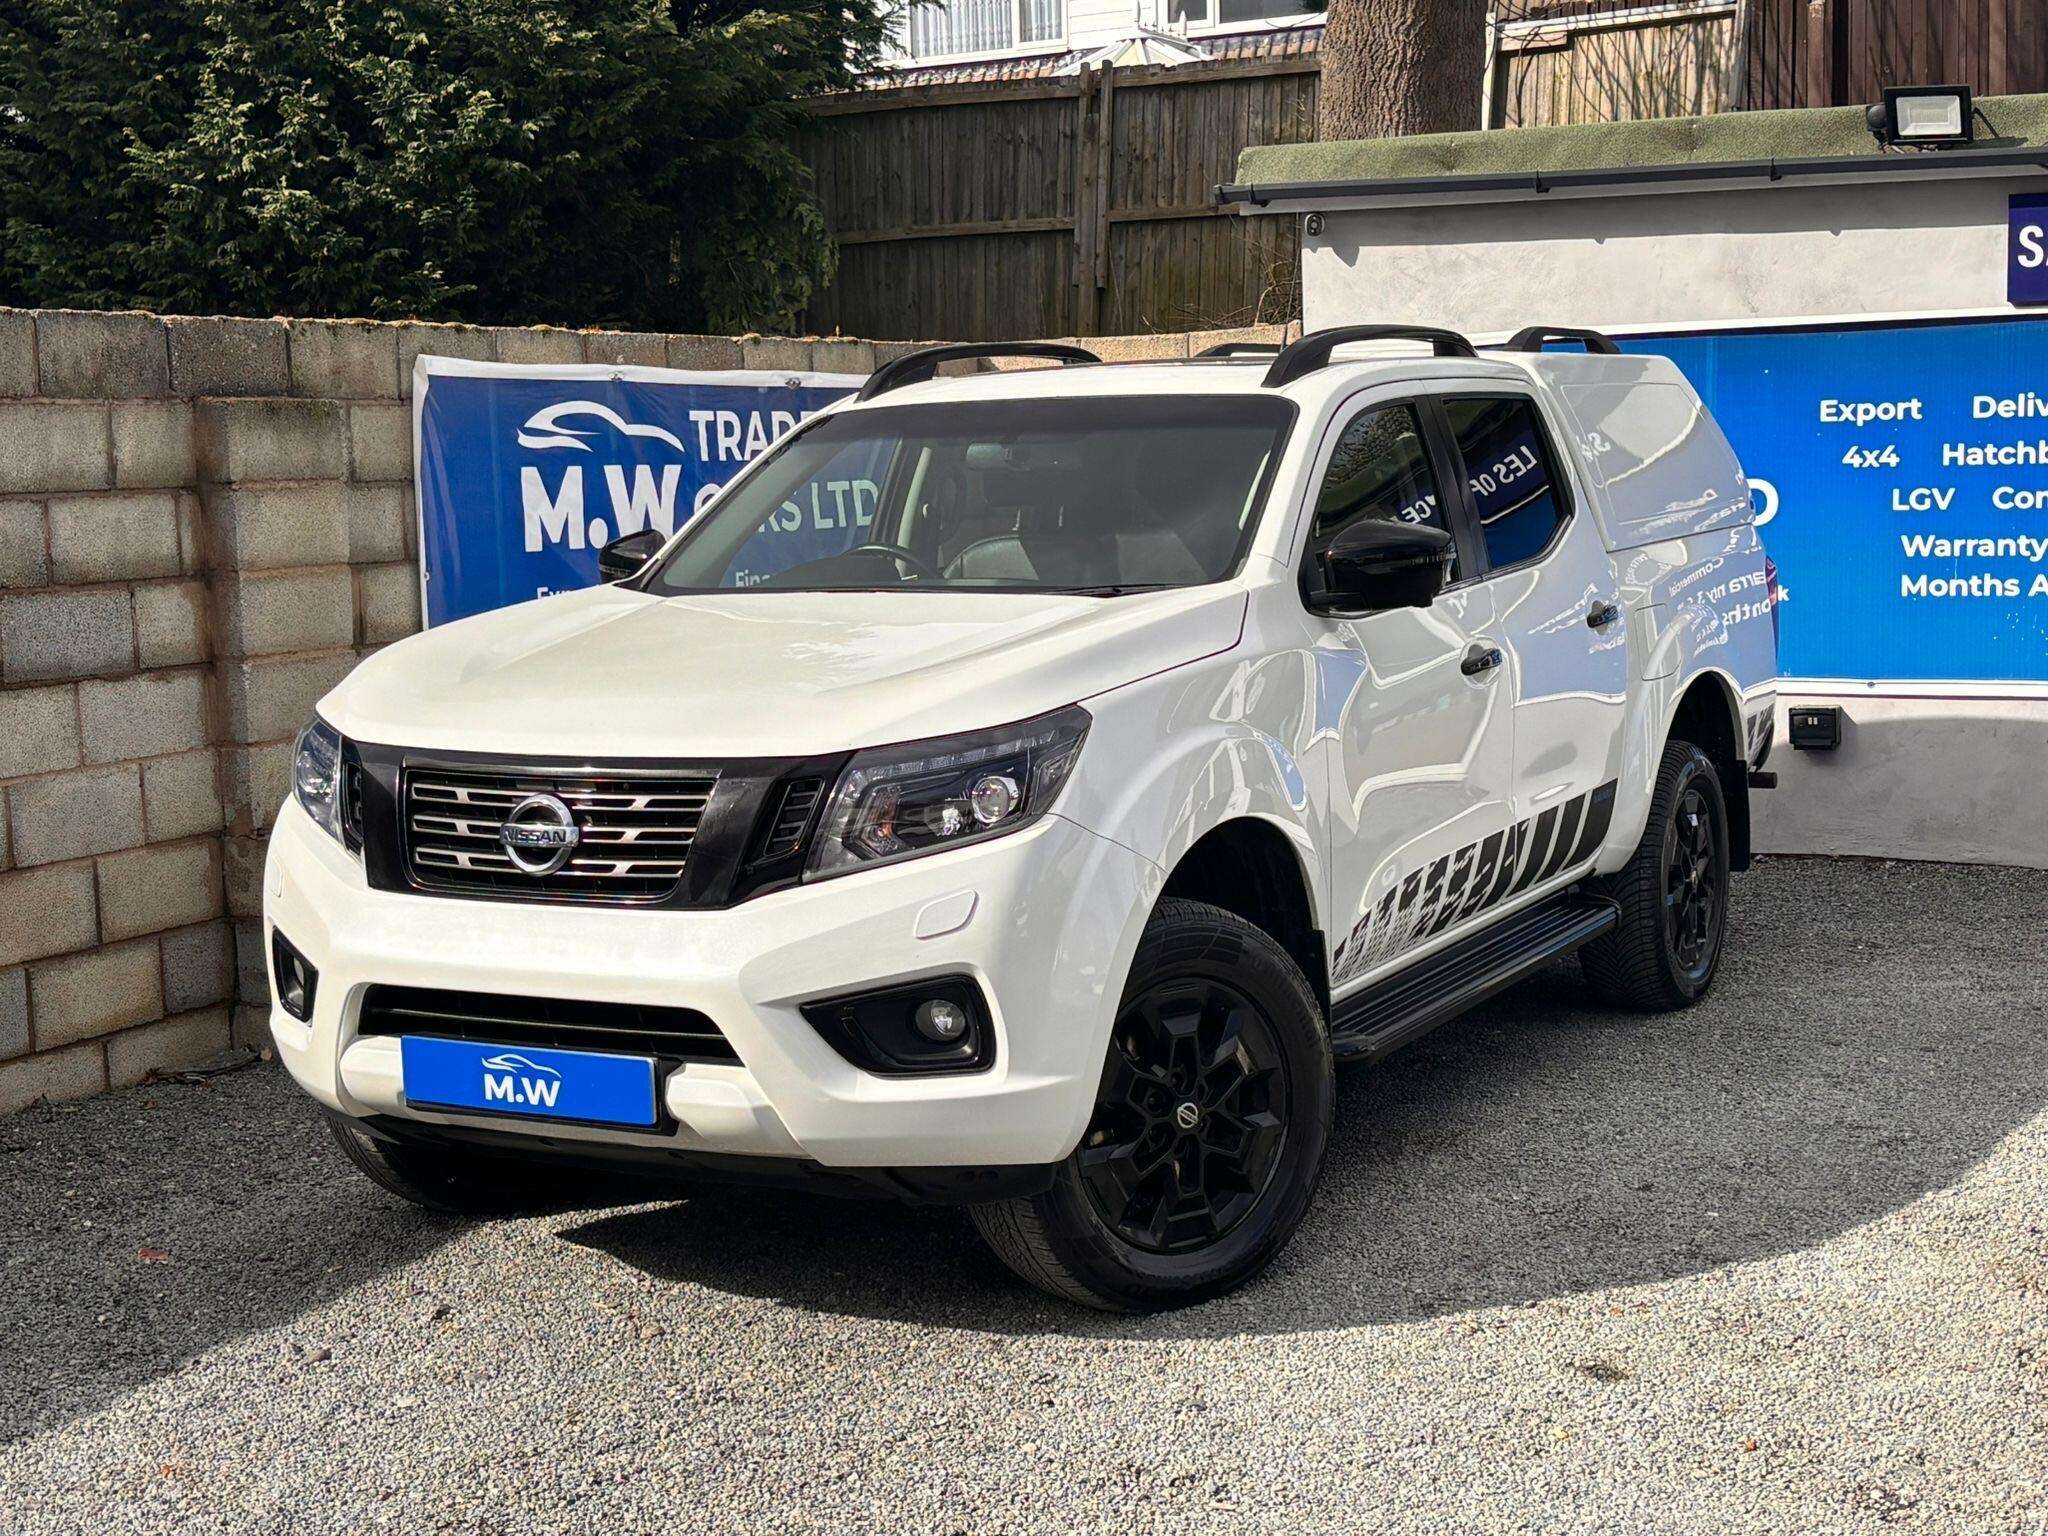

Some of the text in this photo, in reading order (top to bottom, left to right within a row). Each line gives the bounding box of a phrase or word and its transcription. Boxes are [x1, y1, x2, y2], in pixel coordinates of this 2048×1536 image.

[2017, 225, 2048, 268] S
[1819, 397, 1923, 427] Export
[1842, 444, 1900, 468] 4x4
[521, 463, 683, 553] M.W
[811, 478, 879, 530] LTD
[1892, 487, 1956, 511] LGV
[1901, 534, 2048, 563] Warranty
[1901, 573, 2020, 598] Months
[501, 826, 567, 843] NISSAN
[484, 1073, 561, 1107] M.W
